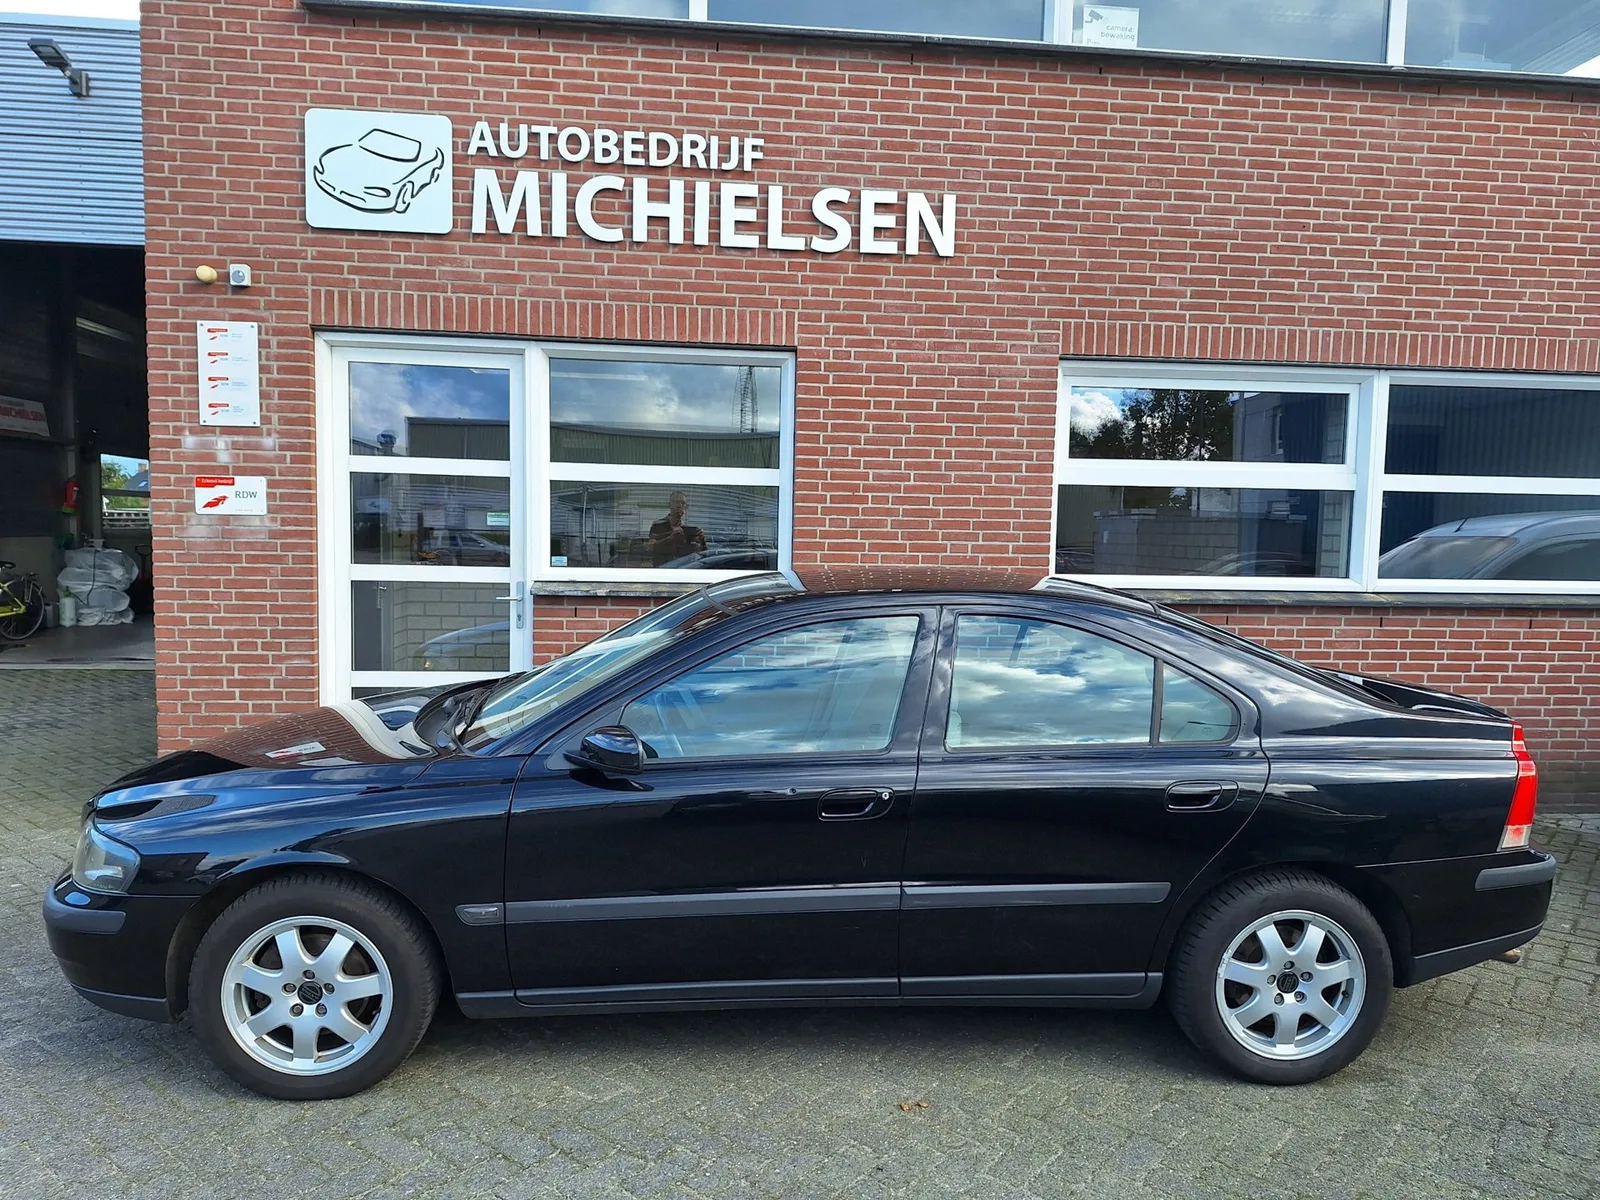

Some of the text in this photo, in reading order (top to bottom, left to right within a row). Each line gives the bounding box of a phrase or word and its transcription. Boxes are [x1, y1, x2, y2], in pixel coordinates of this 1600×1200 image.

[1106, 25, 1133, 33] camera
[1101, 31, 1135, 41] bewaking
[467, 121, 764, 171] AUTOBEDRIJF
[471, 168, 957, 257] MICHIELSEN
[235, 490, 258, 499] RDW
